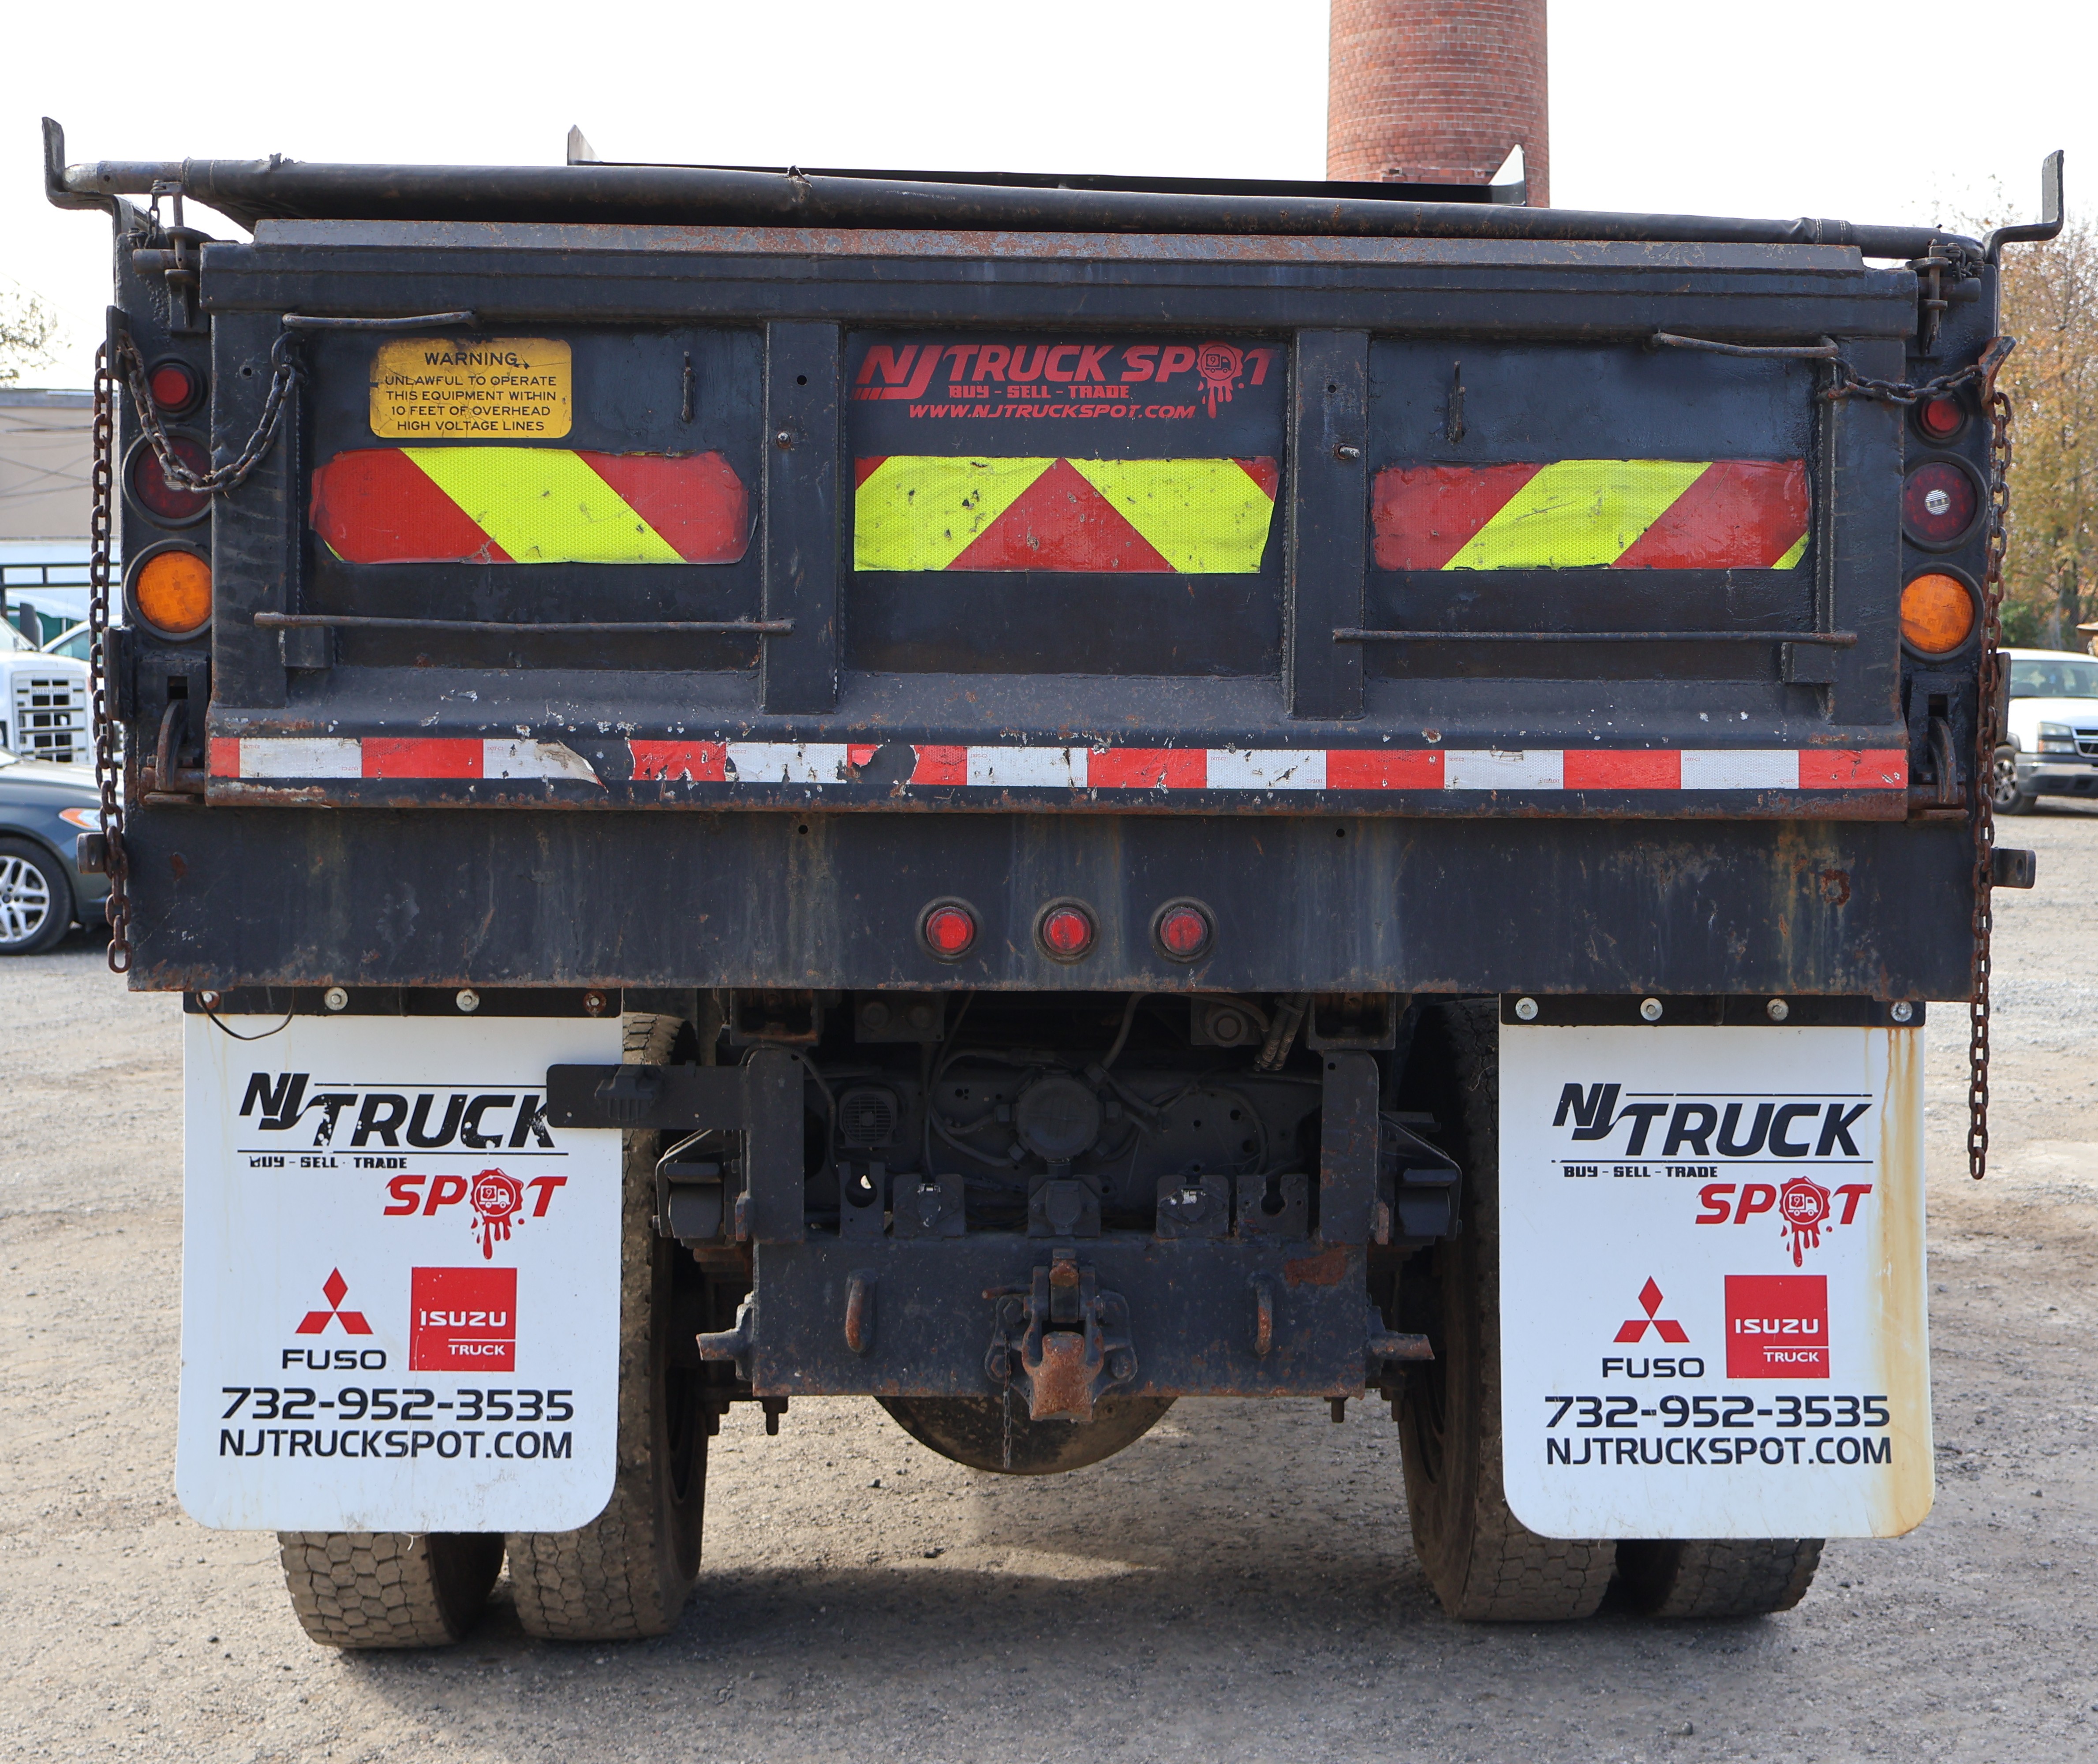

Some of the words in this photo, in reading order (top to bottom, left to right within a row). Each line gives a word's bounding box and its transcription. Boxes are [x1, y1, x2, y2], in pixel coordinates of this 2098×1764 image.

[425, 352, 517, 366] WARNING
[852, 345, 945, 400] NJ
[942, 345, 1114, 382] TRUCK
[385, 376, 464, 386] UNLAWFUL
[468, 376, 486, 386] TO
[490, 376, 557, 386] OPERATE
[386, 391, 418, 401] THIS
[423, 391, 503, 401] EQUIPMENT
[510, 391, 556, 401] WITHIN
[948, 385, 989, 398] BUY
[1007, 385, 1051, 398] SELL
[1068, 385, 1129, 398] TRADE
[391, 406, 405, 415] 10
[410, 406, 445, 415] FEET
[450, 406, 467, 415] OF
[472, 406, 551, 416] OVERHEAD
[909, 405, 1197, 419] WWW.NJTRUCKSPOT.COM
[397, 421, 430, 431] HIGH
[435, 421, 499, 431] VOLTAGE
[503, 421, 545, 431] LINES
[239, 1073, 310, 1130] NJ
[300, 1094, 555, 1148] TRUCK
[1552, 1083, 1622, 1140] NJ
[1612, 1103, 1873, 1157] TRUCK
[250, 1156, 284, 1168] BUY
[300, 1157, 339, 1168] SELL
[354, 1157, 408, 1169] TRADE
[1563, 1166, 1598, 1177] BUY
[1613, 1166, 1651, 1177] SELL
[1665, 1166, 1718, 1177] TRADE
[420, 1311, 507, 1327] ISUZU
[1735, 1318, 1819, 1334] ISUZU
[448, 1344, 505, 1356] TRUCK
[1763, 1351, 1820, 1363] TRUCK
[282, 1349, 386, 1370] FUSO
[1602, 1357, 1705, 1378] FUSO
[221, 1387, 574, 1421] 732-952-3535
[1545, 1395, 1890, 1428] 732-952-3535
[220, 1429, 572, 1459] NJTRUCKSPOT.COM
[1547, 1437, 1892, 1465] NJTRUCKSPOT.COM
